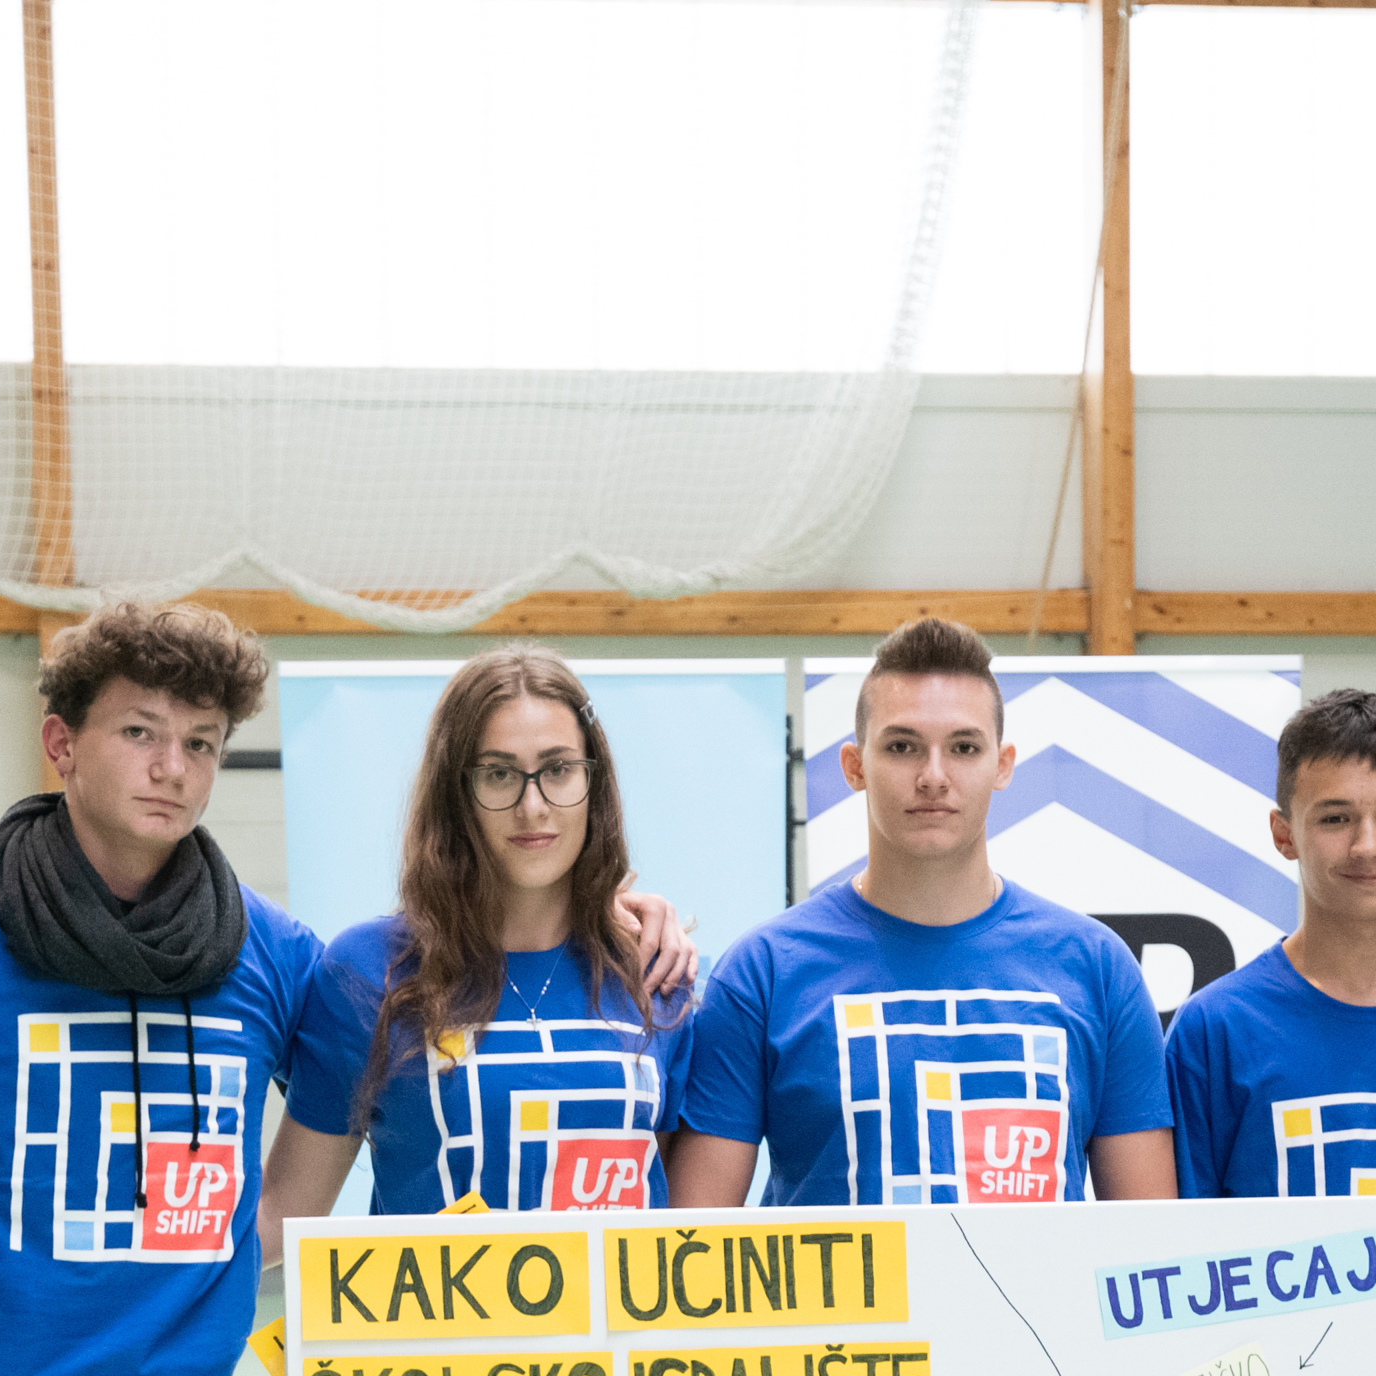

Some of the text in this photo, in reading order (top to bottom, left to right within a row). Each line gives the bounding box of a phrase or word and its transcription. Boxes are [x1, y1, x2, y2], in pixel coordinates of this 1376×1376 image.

[984, 1125, 1051, 1171] UP
[164, 1161, 228, 1208] UP
[571, 1157, 639, 1204] UP
[980, 1170, 1049, 1198] SHIFT
[155, 1210, 226, 1235] SHIFT
[330, 1229, 875, 1324] KAKO UČINITI
